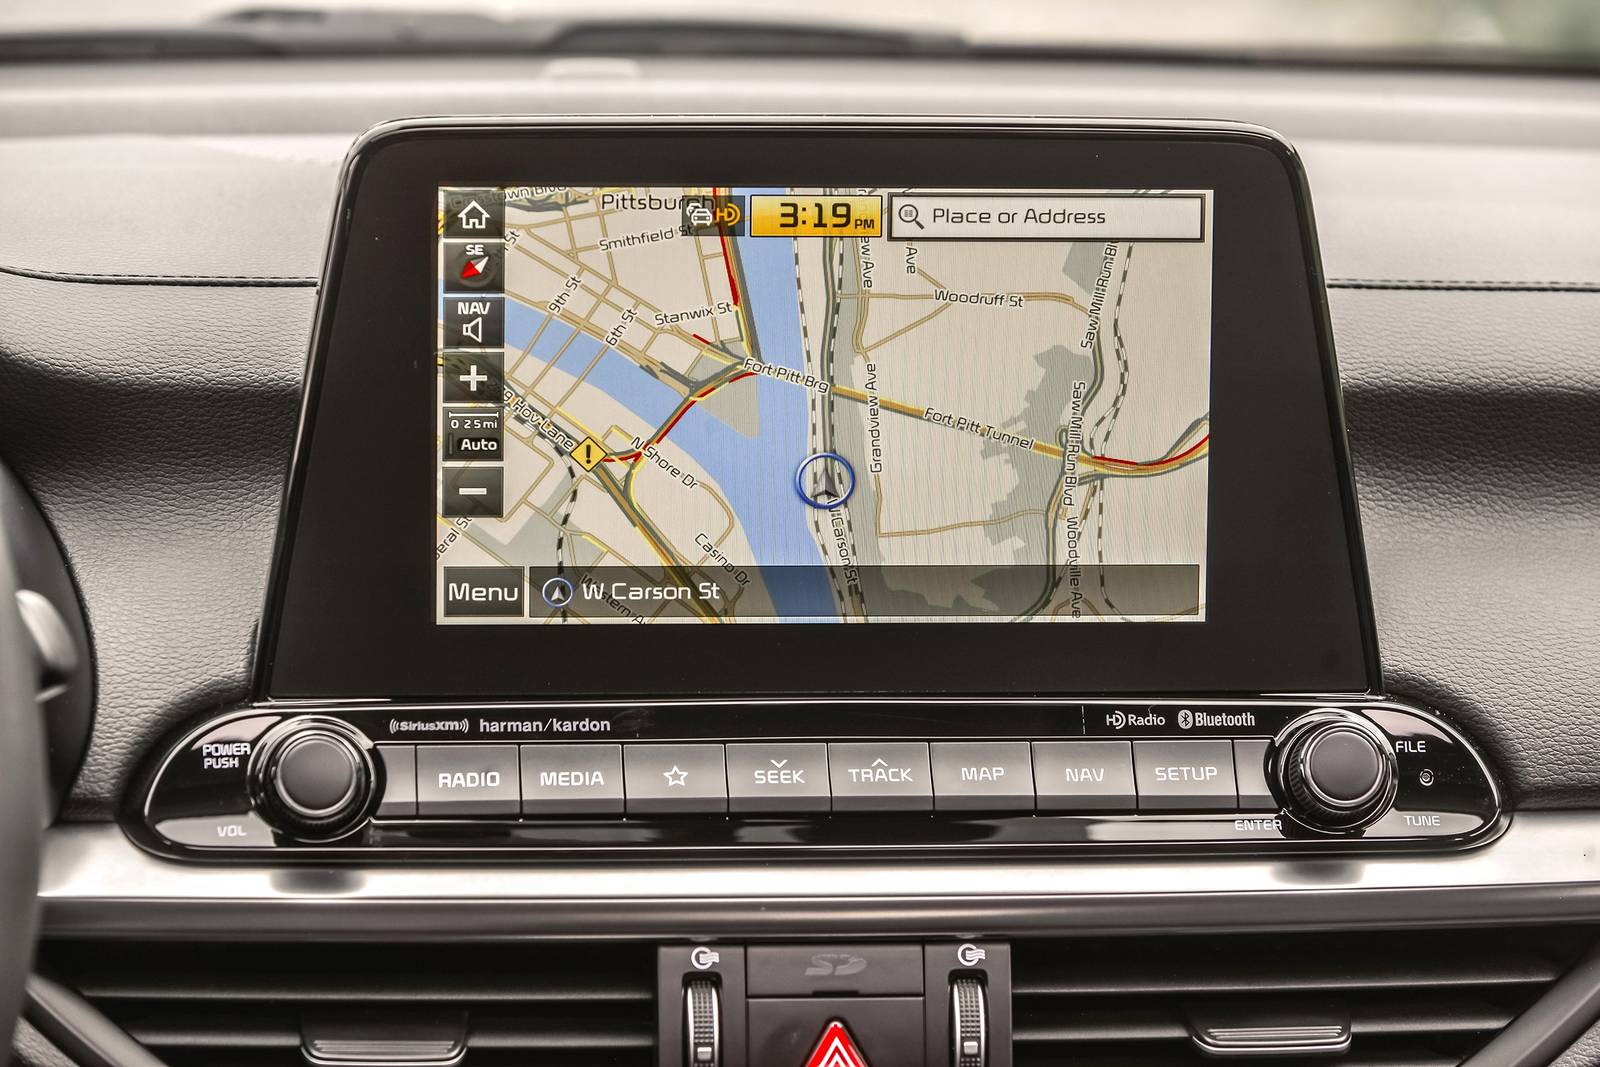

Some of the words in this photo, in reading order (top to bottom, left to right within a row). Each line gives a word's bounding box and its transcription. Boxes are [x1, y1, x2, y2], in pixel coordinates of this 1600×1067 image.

[780, 202, 851, 228] 3:19
[854, 219, 875, 229] PM
[933, 208, 991, 224] Place
[998, 211, 1018, 224] or
[1024, 208, 1106, 224] Address
[599, 227, 674, 251] Smithfield
[679, 224, 695, 236] St
[465, 244, 484, 255] SE
[1104, 241, 1119, 256] Bl
[905, 246, 918, 274] Ave
[862, 260, 875, 288] Ave
[1096, 261, 1114, 288] Run
[549, 290, 570, 313] 9th
[565, 275, 582, 292] St
[934, 289, 1006, 306] Woodruff
[1008, 294, 1024, 308] St
[1089, 291, 1106, 316] Mill
[457, 301, 490, 315] NAV
[654, 305, 714, 326] Stanwix
[717, 302, 732, 315] St
[605, 323, 626, 347] 6th
[622, 307, 638, 324] St
[1081, 318, 1099, 349] Saw
[743, 358, 773, 375] Fort
[775, 367, 801, 384] Pitt
[804, 376, 829, 394] Brg
[865, 363, 877, 391] Ave
[1072, 381, 1086, 412] Saw
[541, 419, 574, 450] Lane
[867, 395, 882, 473] Grandview
[924, 407, 953, 424] Fort
[956, 417, 982, 434] Pitt
[985, 426, 1034, 450] Tunnel
[1069, 416, 1083, 440] Mill
[460, 438, 498, 451] Auto
[630, 436, 644, 450] N
[644, 446, 681, 478] Shore
[681, 473, 698, 489] Dr
[1065, 444, 1080, 471] Run
[1063, 476, 1077, 507] Blvd
[831, 517, 851, 567] Carson
[1067, 516, 1082, 587] Woodville
[694, 532, 734, 574] Casino
[734, 570, 750, 586] Dr
[449, 583, 519, 601] Menu
[582, 583, 604, 600] W
[612, 583, 691, 600] Carson
[698, 583, 721, 600] St
[1071, 591, 1083, 619] Ave
[479, 718, 611, 733] harman/kardon
[1128, 713, 1166, 727] Radio
[1195, 712, 1256, 727] Bluetooth
[202, 743, 252, 757] POWER
[1395, 741, 1427, 753] FILE
[203, 757, 239, 769] PUSH
[438, 771, 500, 788] RADIO
[540, 771, 604, 786] MEDIA
[754, 769, 805, 784] SEEK
[848, 768, 913, 782] TRACK
[961, 767, 1005, 781] MAP
[1065, 768, 1105, 782] NAV
[1154, 767, 1218, 781] SETUP
[217, 825, 247, 837] VOL
[1234, 820, 1283, 831] ENTER
[1404, 815, 1441, 826] TUNE
